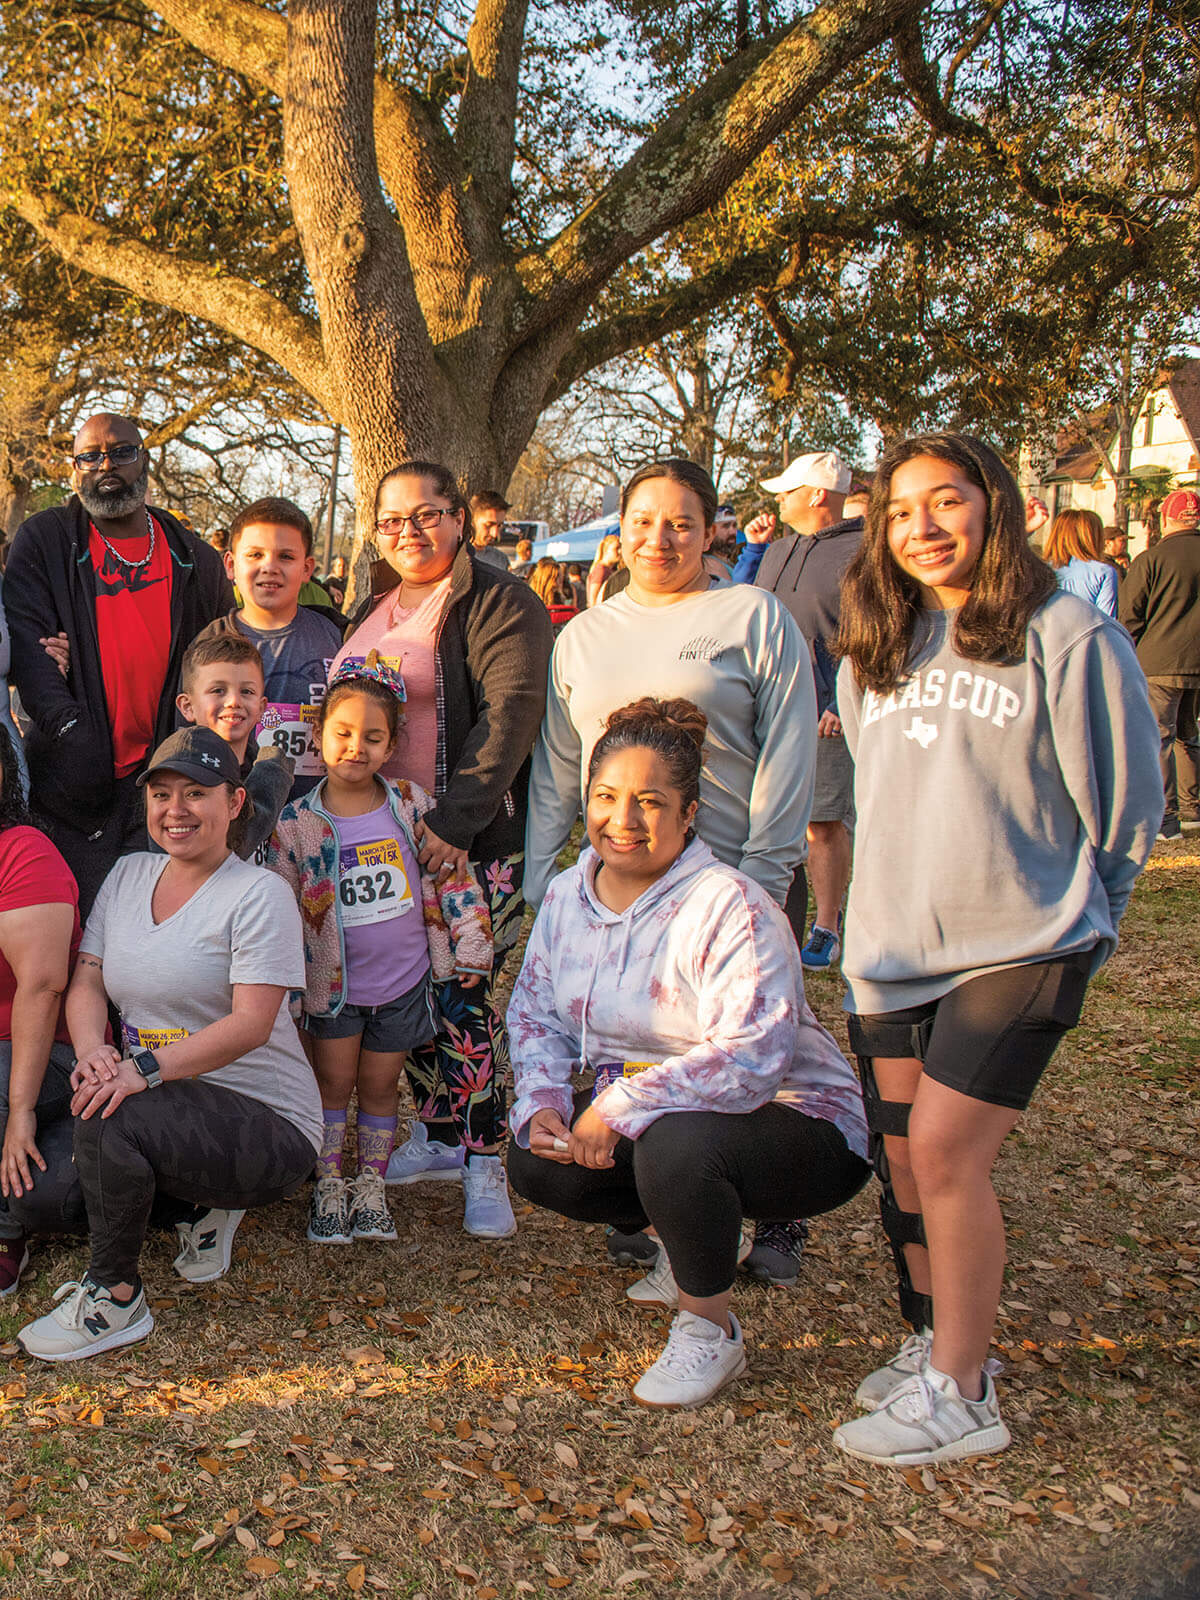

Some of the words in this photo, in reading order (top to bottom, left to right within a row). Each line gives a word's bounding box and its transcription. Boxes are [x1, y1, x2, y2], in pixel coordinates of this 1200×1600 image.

[949, 670, 1022, 729] CUP
[272, 729, 321, 757] 854
[340, 870, 396, 907] 632
[140, 1032, 159, 1040] MARCH
